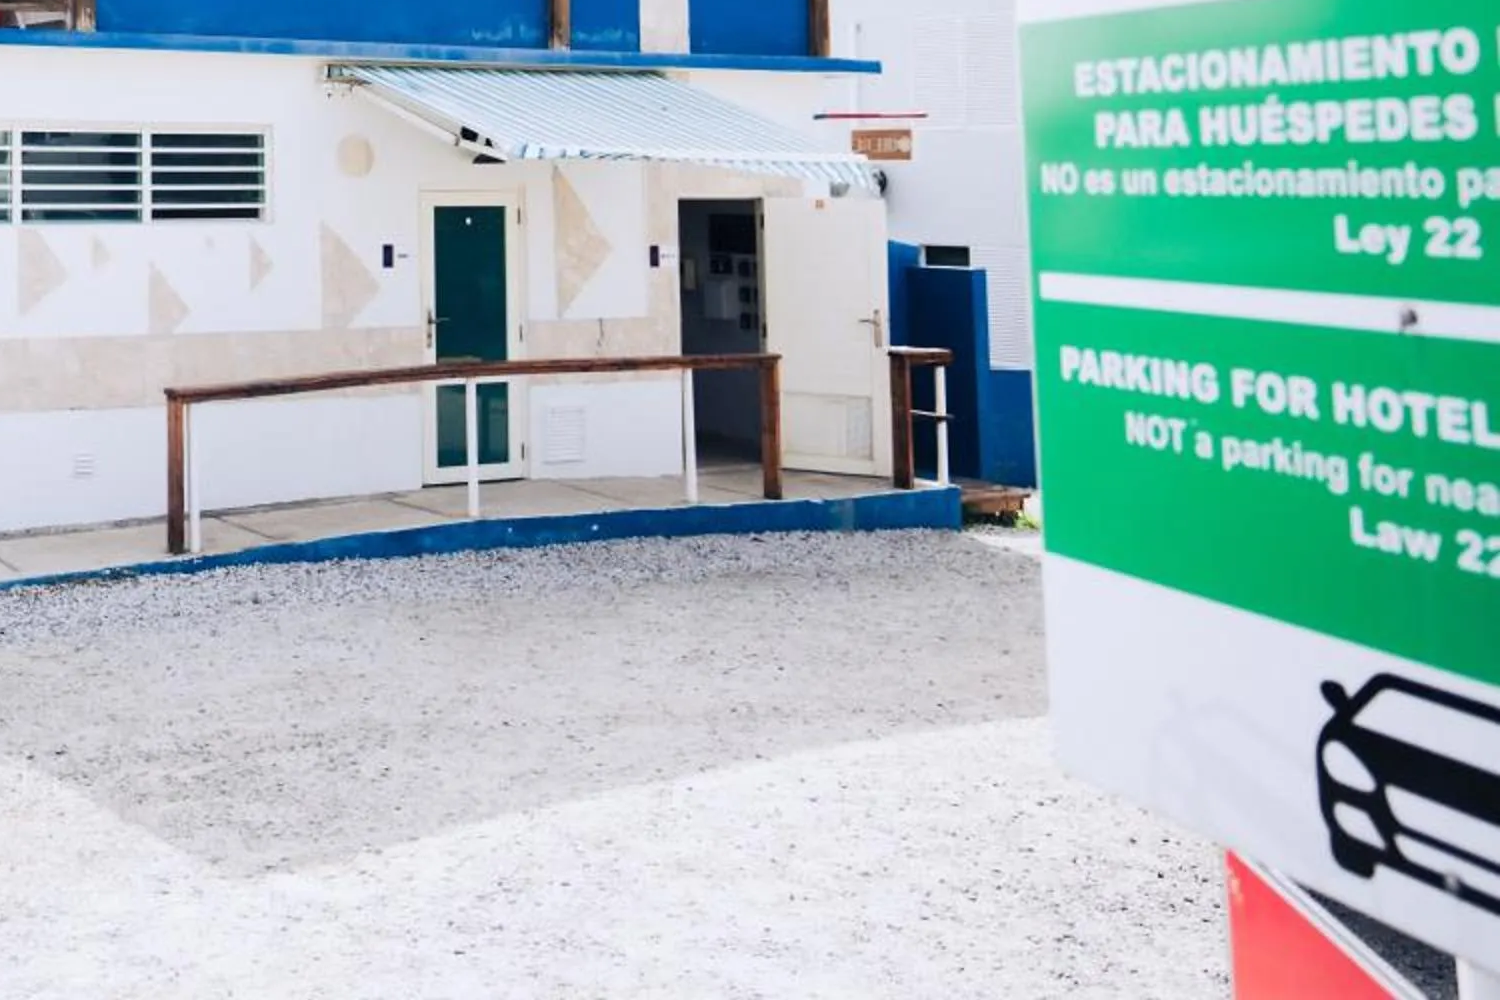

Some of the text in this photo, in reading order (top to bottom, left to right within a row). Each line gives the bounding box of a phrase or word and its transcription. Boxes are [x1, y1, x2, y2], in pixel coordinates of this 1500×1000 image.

[1073, 26, 1480, 98] ESTACIONAMIENTO
[1094, 107, 1191, 149] PARA
[1199, 94, 1478, 147] HUÉSPEDES
[1040, 162, 1079, 195] NO
[1084, 169, 1115, 196] es
[1123, 168, 1158, 195] un
[1164, 160, 1445, 199] estacionamiento
[1333, 214, 1482, 265] Ley 22
[1059, 344, 1500, 450] PARKING FOR HOTEL
[1123, 411, 1187, 454] NOT
[1194, 430, 1214, 460] a
[1221, 437, 1349, 495] parking
[1358, 451, 1414, 498] for
[1350, 505, 1441, 562] Law
